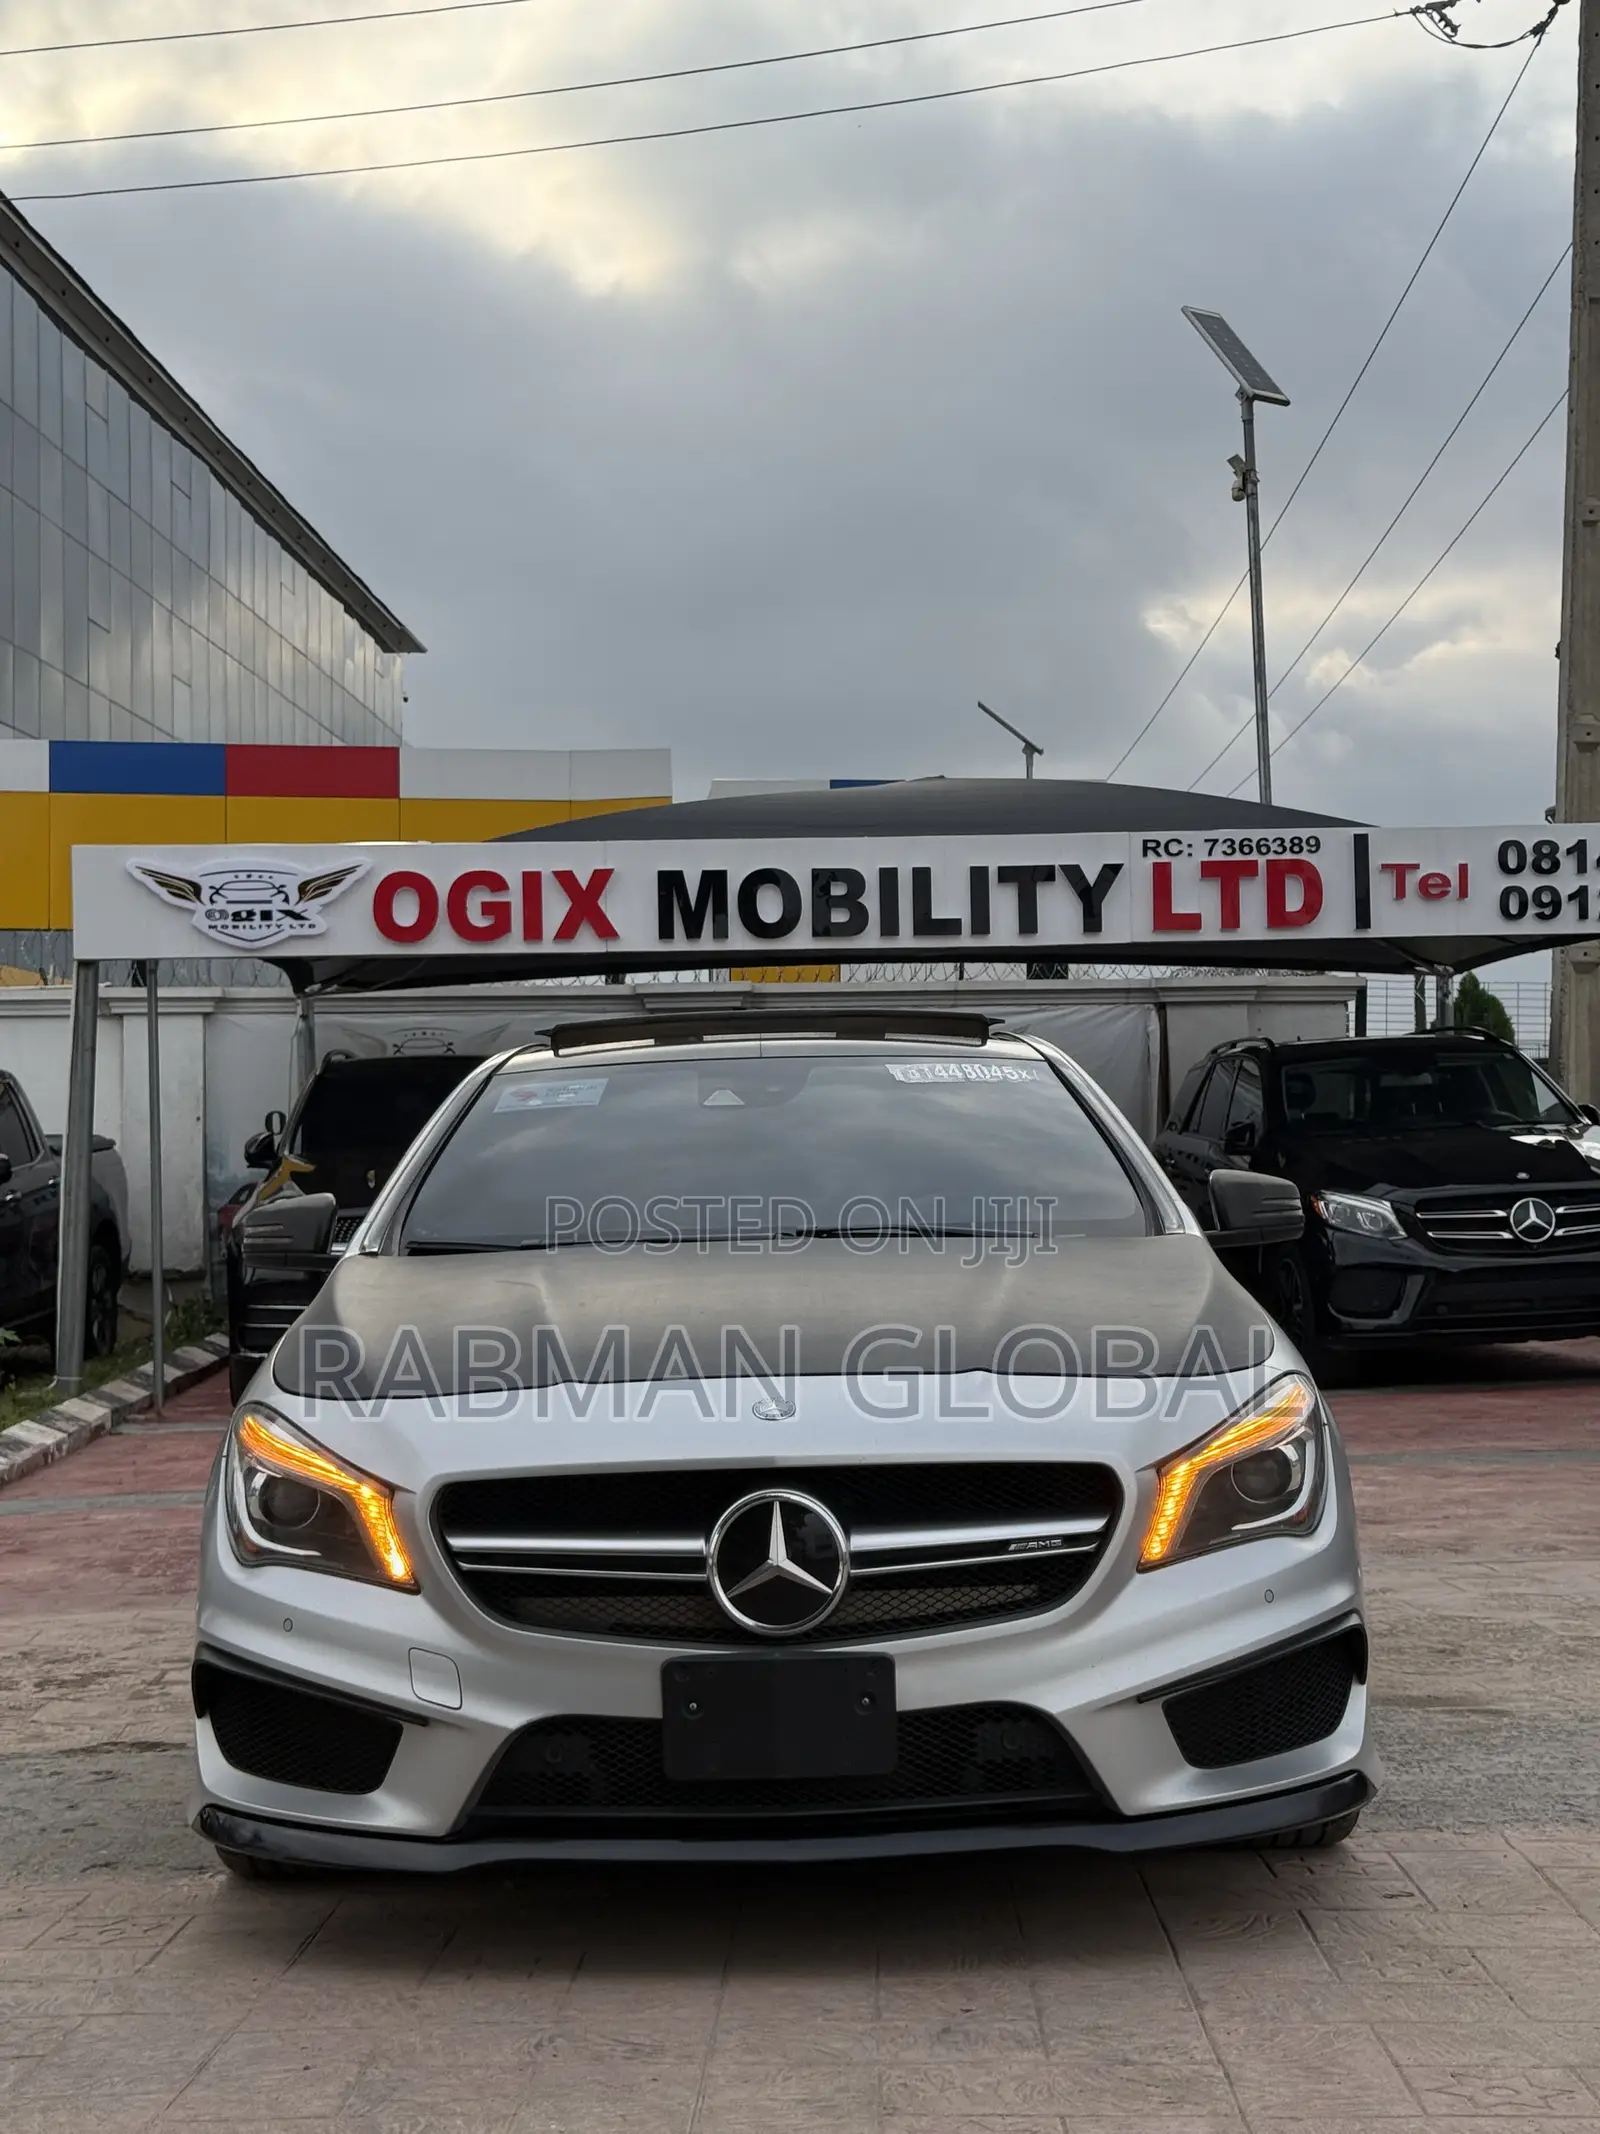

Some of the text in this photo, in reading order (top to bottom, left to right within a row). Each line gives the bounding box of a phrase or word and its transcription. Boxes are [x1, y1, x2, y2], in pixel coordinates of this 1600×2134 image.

[1142, 835, 1322, 858] RC: 7366389
[1497, 838, 1600, 875] 081
[1381, 863, 1469, 901] Tel
[372, 859, 1324, 944] OGIX MOBILITY LTD
[1499, 884, 1600, 921] 091
[207, 923, 284, 931] MOBILITY
